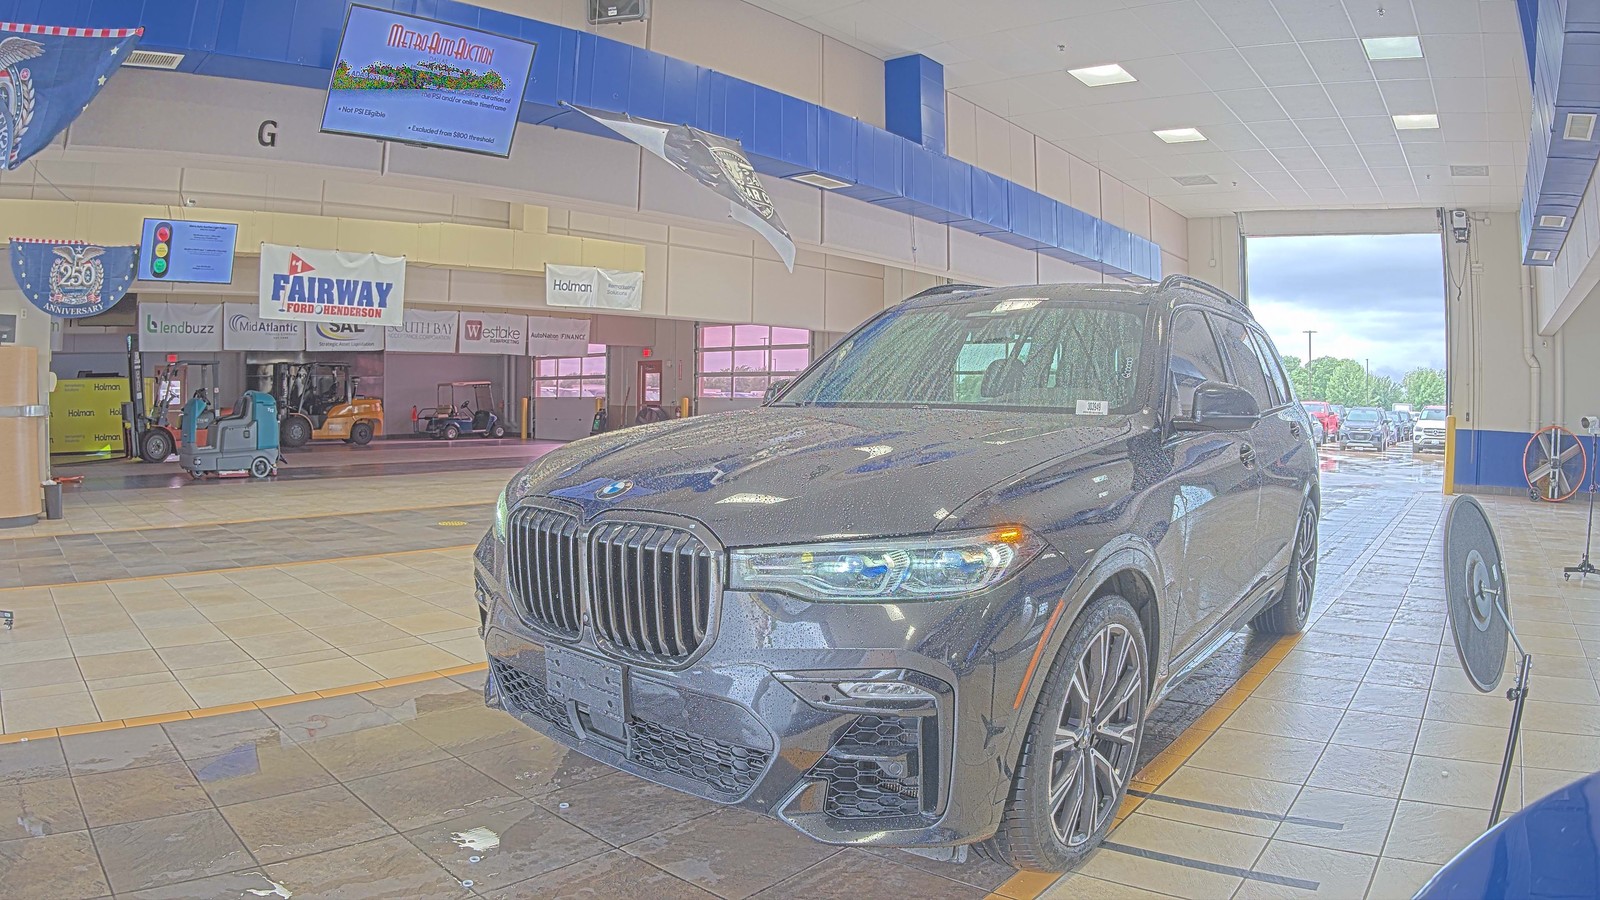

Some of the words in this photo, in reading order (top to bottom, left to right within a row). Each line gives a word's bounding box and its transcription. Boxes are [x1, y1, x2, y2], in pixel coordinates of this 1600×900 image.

[431, 92, 441, 100] PSI
[441, 95, 462, 103] and/or
[462, 99, 479, 107] online
[479, 102, 507, 112] timeframe
[480, 94, 505, 104] duration
[341, 106, 353, 114] Not
[354, 107, 364, 115] PSI
[364, 109, 386, 119] Eligible
[257, 120, 278, 147] G
[411, 125, 438, 136] Excluded
[438, 128, 452, 137] from
[468, 133, 495, 144] threshold
[59, 263, 95, 287] 250
[271, 273, 393, 309] FAIRWAY
[553, 279, 593, 293] Holman
[43, 302, 104, 315] ANNIVERSARY
[286, 302, 314, 314] FORD
[323, 304, 382, 319] HENDERSON
[160, 321, 214, 334] lendbuzz
[239, 320, 298, 333] MidAtlantic
[387, 321, 429, 334] SOUTH
[433, 323, 454, 335] BAY
[466, 323, 521, 340] Westlake
[530, 331, 559, 339] AutoNation
[560, 333, 586, 341] FINANCE
[94, 383, 121, 391] Holman
[68, 409, 95, 417] Holman
[109, 408, 122, 416] Hol
[94, 433, 121, 441] Holman
